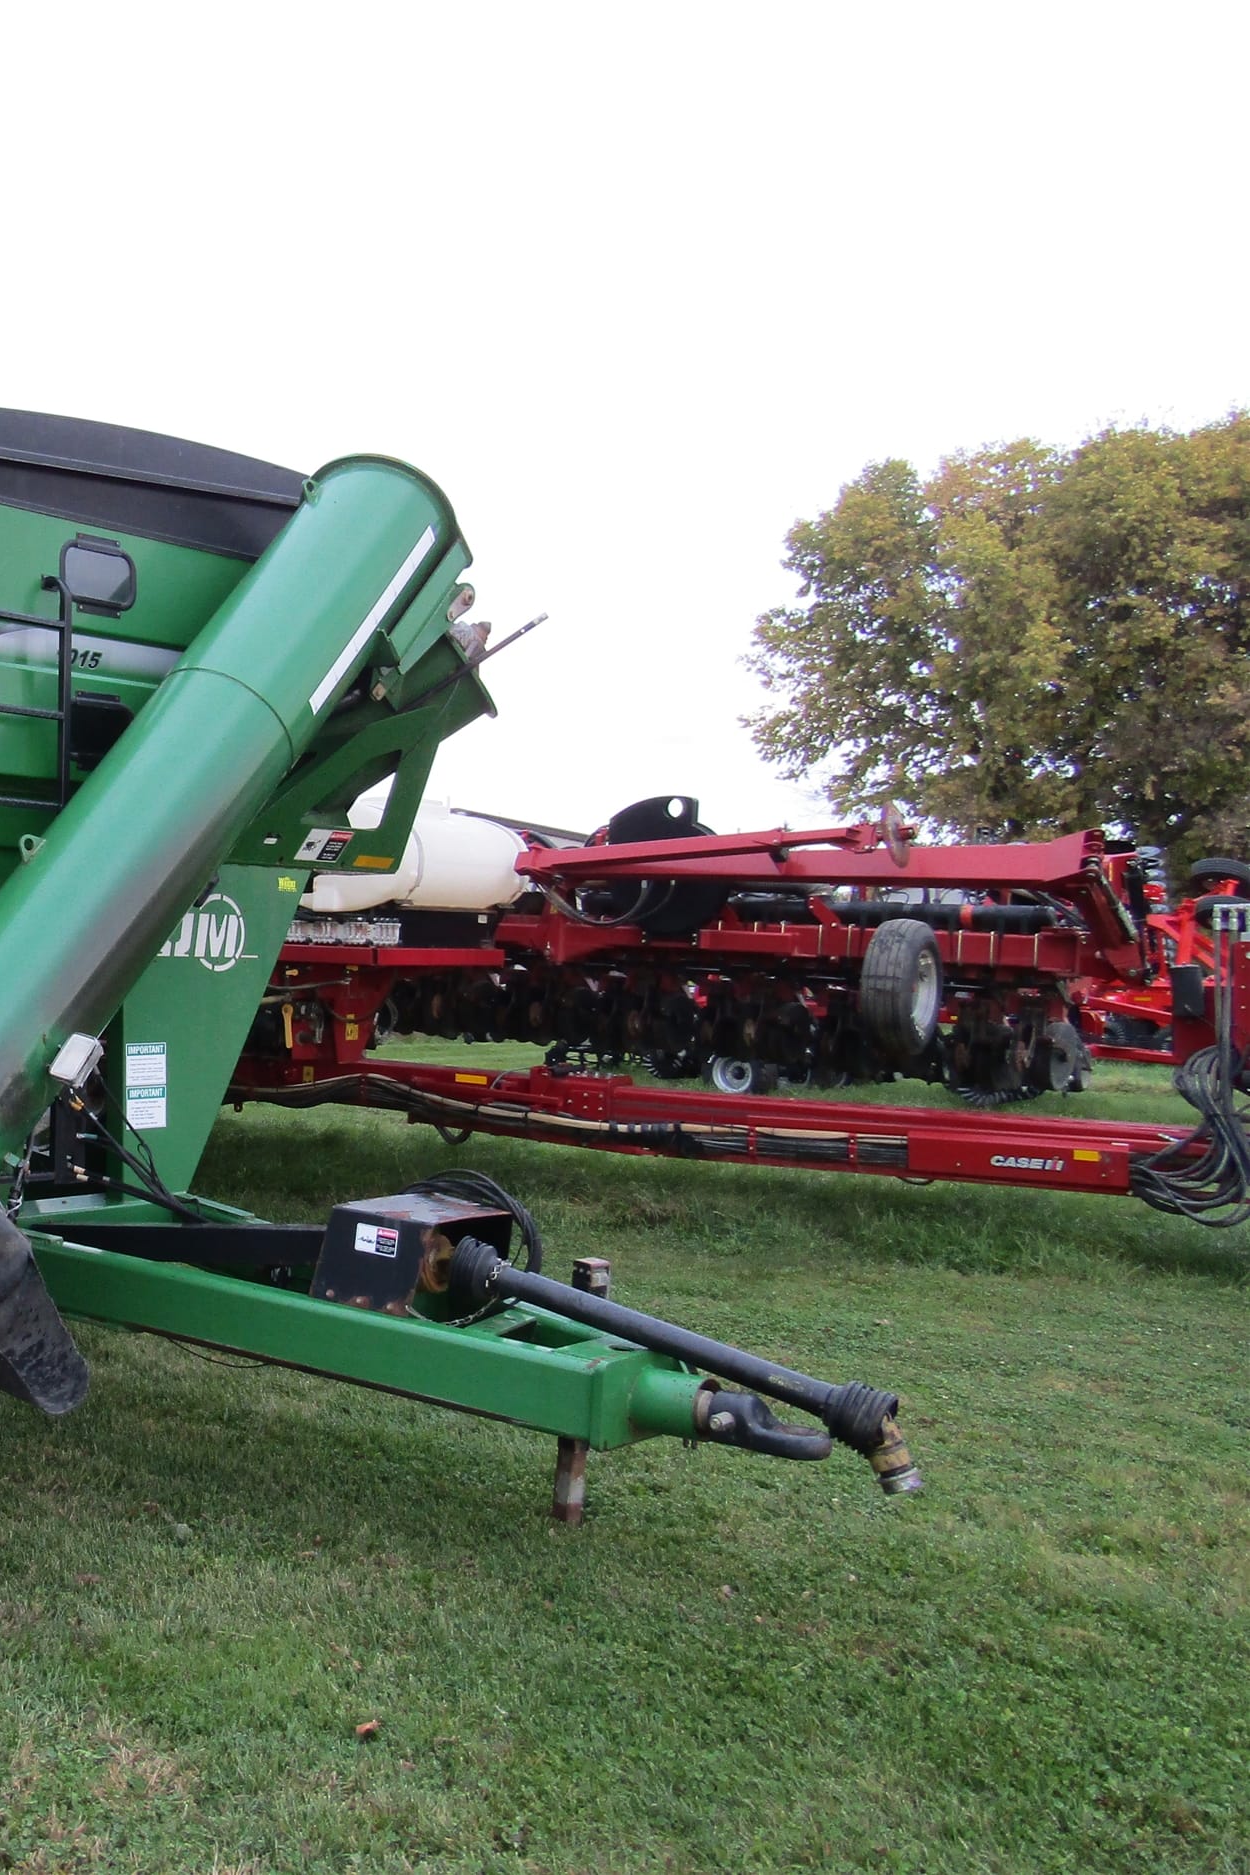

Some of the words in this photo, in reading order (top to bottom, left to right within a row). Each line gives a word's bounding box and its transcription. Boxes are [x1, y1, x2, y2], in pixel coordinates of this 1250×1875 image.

[127, 1045, 164, 1055] IMPORTANT
[129, 1088, 163, 1098] IMPORTANT
[990, 1155, 1044, 1169] CASE
